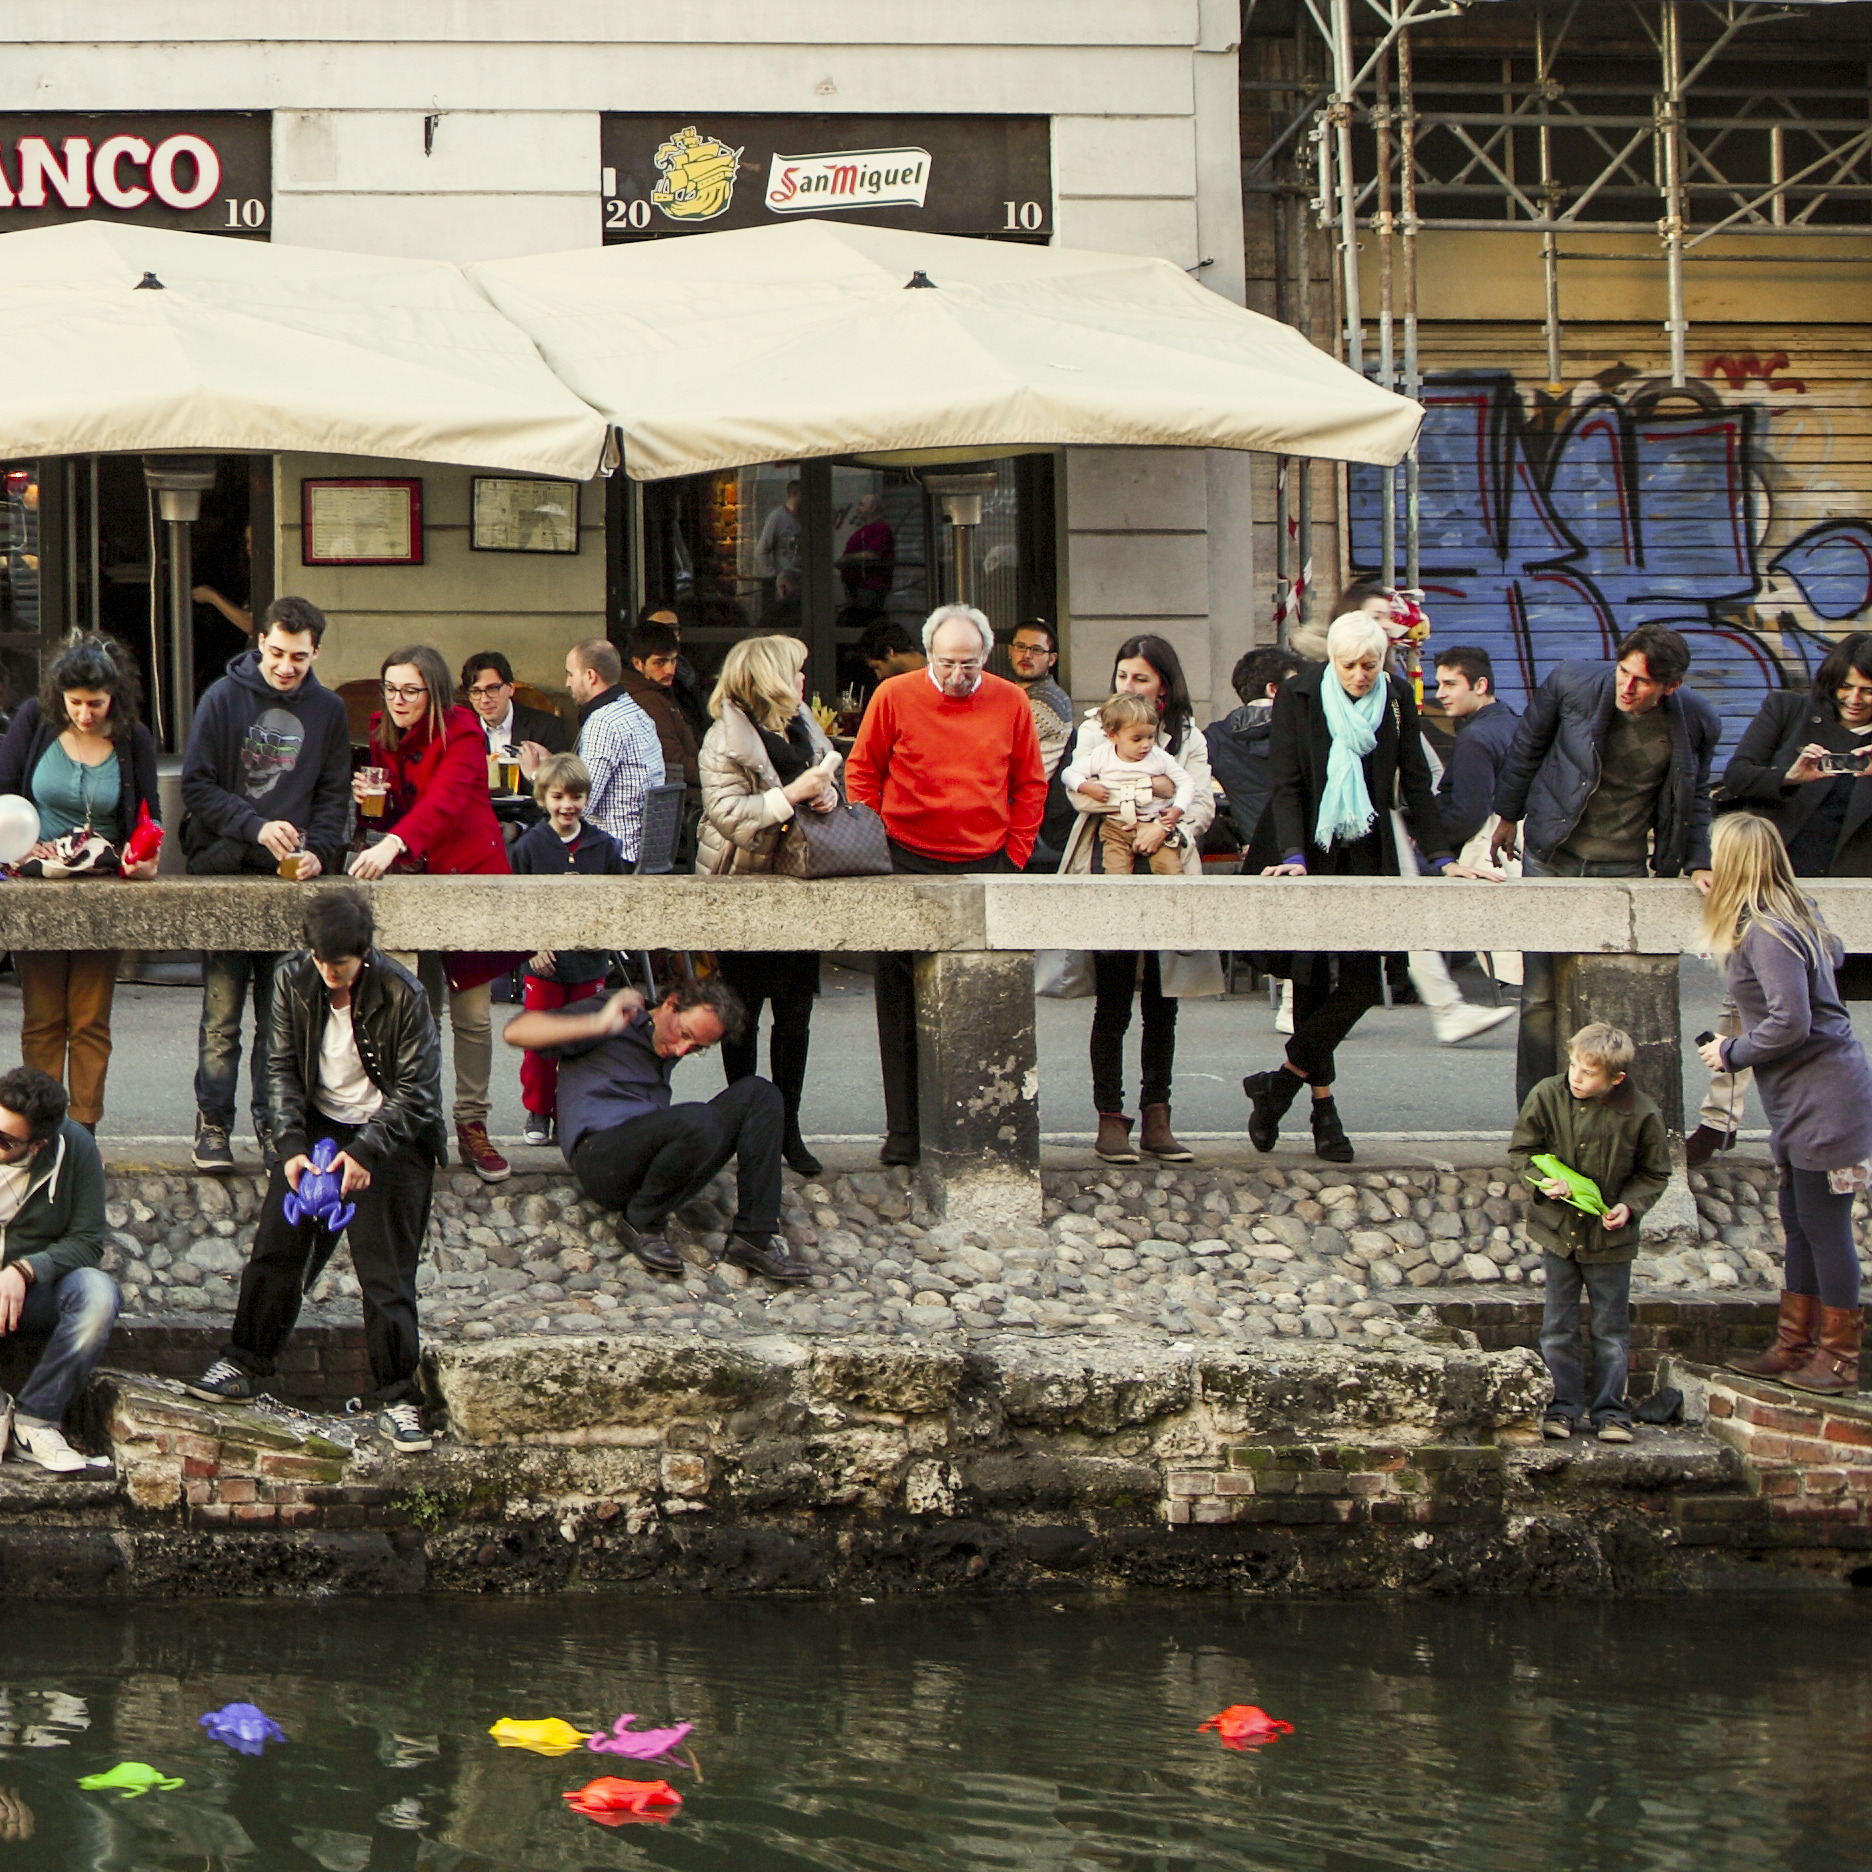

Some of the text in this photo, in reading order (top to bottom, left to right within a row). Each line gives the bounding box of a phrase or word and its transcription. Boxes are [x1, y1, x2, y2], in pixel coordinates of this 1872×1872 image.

[224, 198, 265, 229] 10
[605, 199, 1043, 231] 20 10
